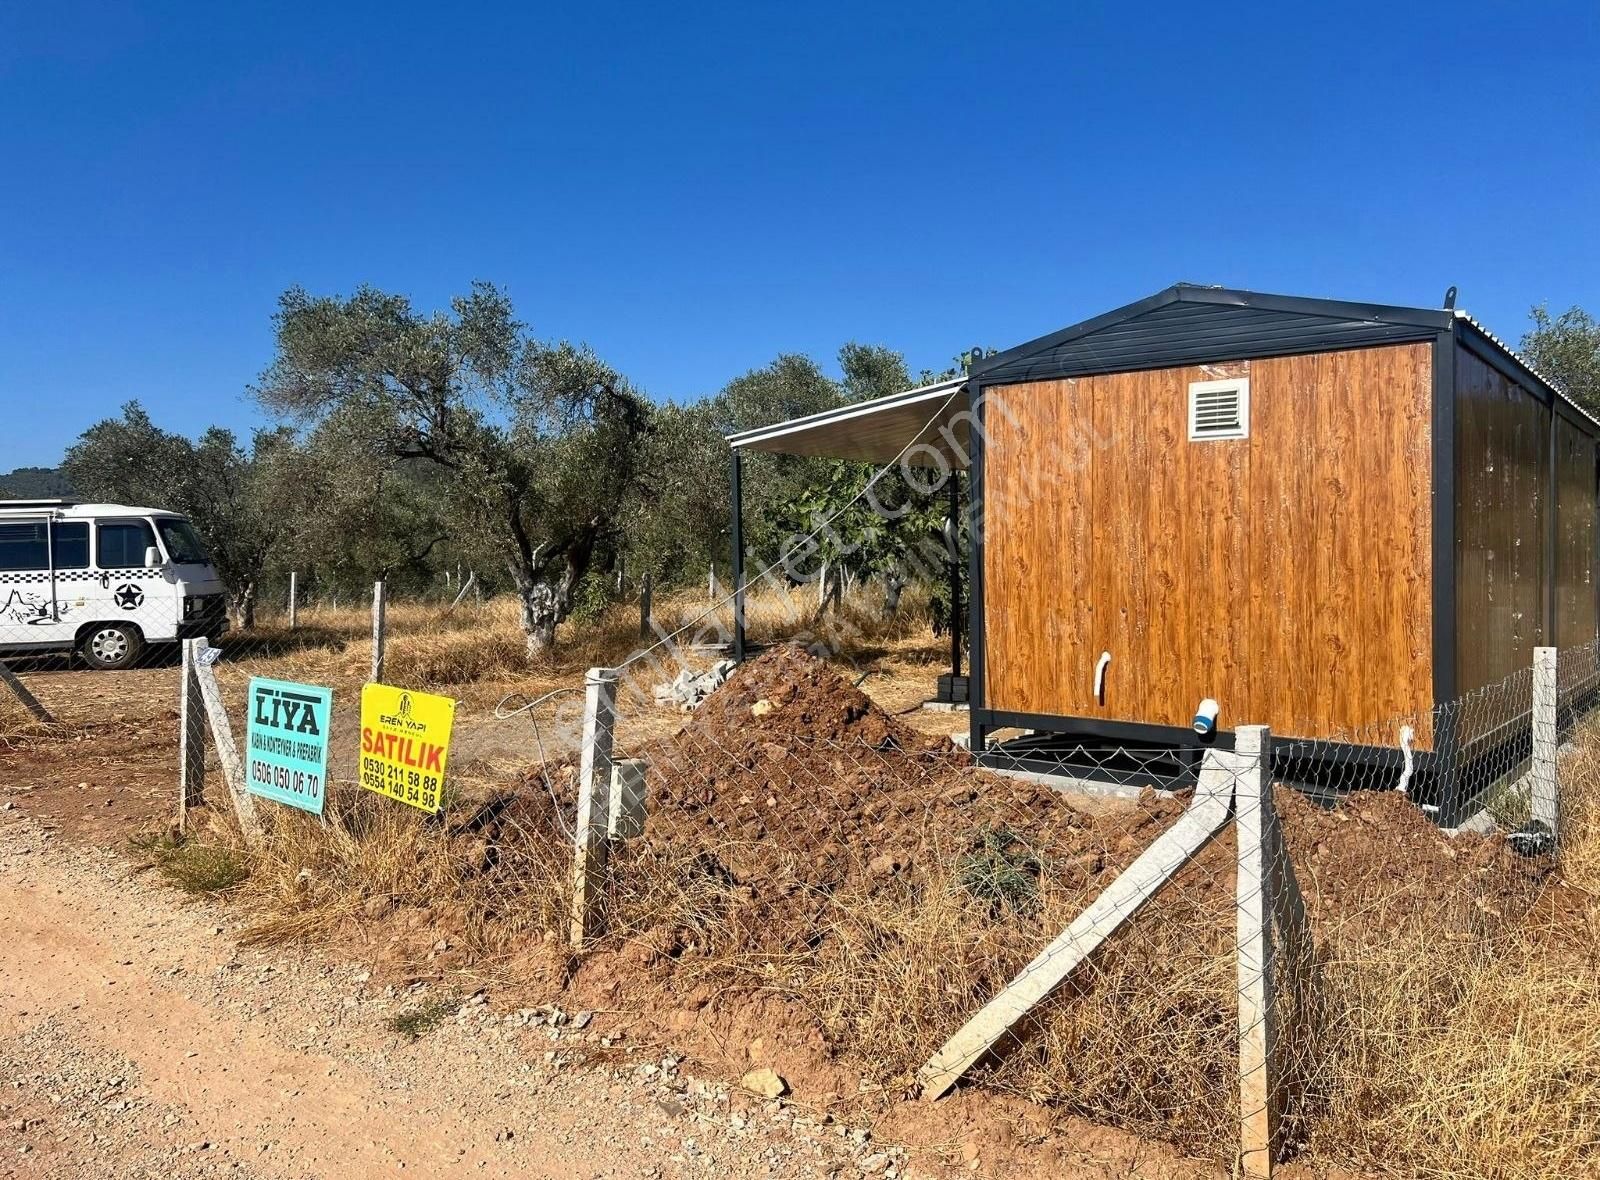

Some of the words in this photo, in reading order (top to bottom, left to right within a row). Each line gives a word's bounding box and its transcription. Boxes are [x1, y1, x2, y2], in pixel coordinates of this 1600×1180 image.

[255, 690, 319, 736] LİYA
[380, 715, 403, 727] EREN
[406, 720, 426, 732] YAPI
[362, 727, 445, 773] SATILIK
[252, 760, 272, 785] 0506
[274, 766, 290, 790] 050
[293, 770, 304, 794] 06
[307, 774, 318, 798] 70
[363, 757, 385, 776] 0530
[387, 765, 404, 782] 211
[407, 771, 420, 788] 58
[423, 775, 437, 792] 88
[363, 772, 385, 790] 0554
[387, 780, 404, 798] 140
[407, 785, 420, 803] 54
[422, 791, 435, 808] 98
